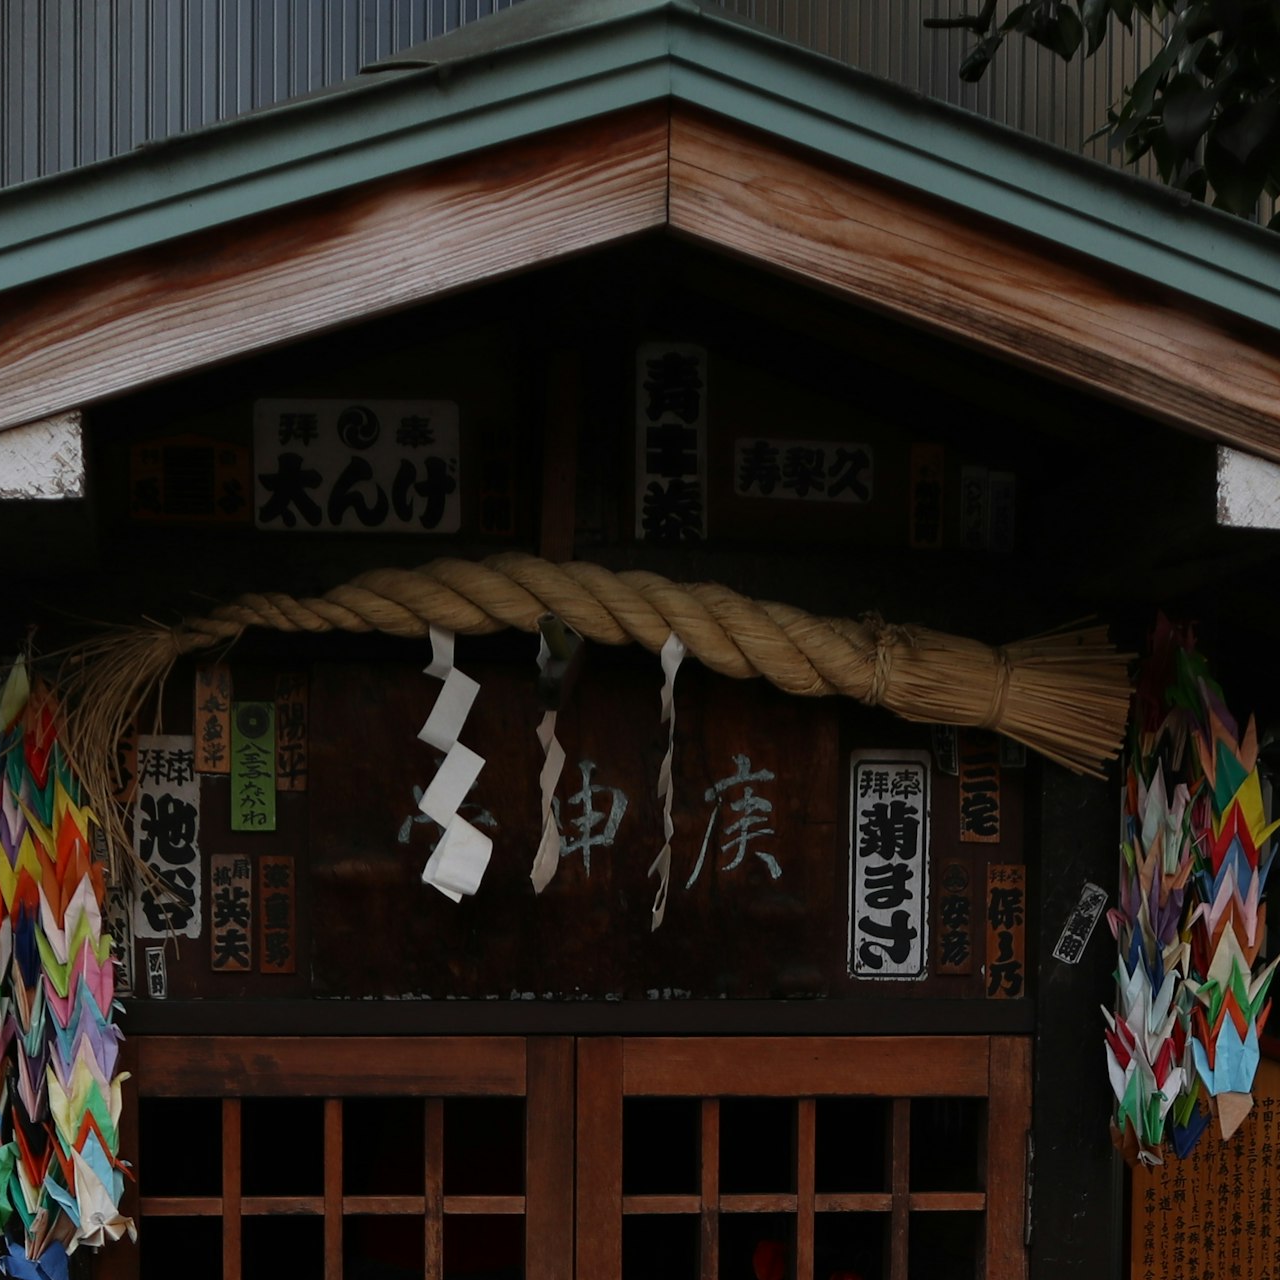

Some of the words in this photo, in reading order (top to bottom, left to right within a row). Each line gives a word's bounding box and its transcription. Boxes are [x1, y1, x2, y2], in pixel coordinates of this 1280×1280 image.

[961, 754, 999, 837] 三宅
[139, 793, 198, 933] 池谷
[214, 888, 251, 968] 英夫
